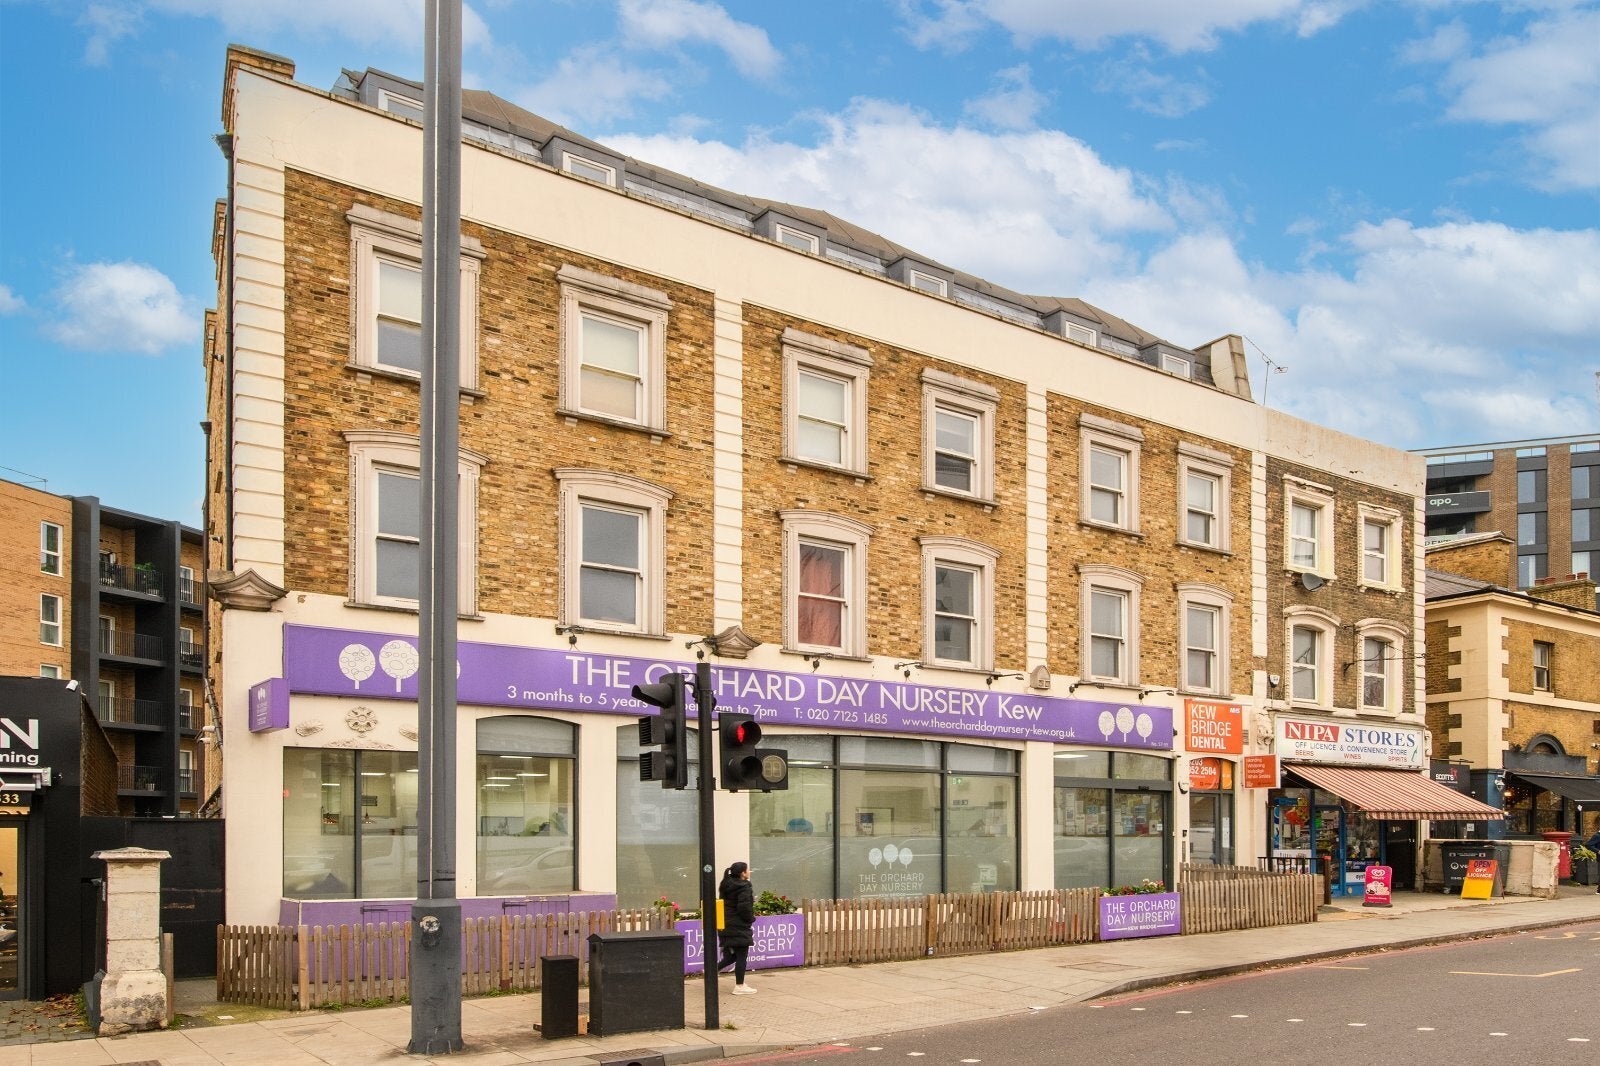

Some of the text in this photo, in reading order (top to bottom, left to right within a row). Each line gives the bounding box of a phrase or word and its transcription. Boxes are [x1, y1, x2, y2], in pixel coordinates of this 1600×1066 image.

[565, 655, 1043, 721] THE ORHARD DAY NURSERY Kew
[507, 686, 517, 698] 3
[523, 688, 574, 703] months
[580, 692, 593, 704] to
[597, 693, 607, 705] 5
[612, 696, 648, 710] years
[737, 703, 749, 714] to
[753, 704, 777, 720] 7pm
[793, 707, 803, 719] T:
[807, 708, 829, 720] 020
[833, 709, 858, 723] 7125
[863, 712, 888, 725] 1485
[1191, 704, 1217, 720] KEW
[901, 717, 1075, 740] www.theorcharddaynursery-kew.org.uk
[1191, 720, 1231, 737] BRIDGE
[1287, 722, 1415, 748] NIPA STORES
[1191, 735, 1227, 750] DENTAL
[1295, 741, 1307, 749] OFF
[1310, 742, 1336, 751] LICENCE
[1346, 745, 1387, 755] CONVENIENCE
[1390, 747, 1407, 756] STORE
[1343, 752, 1362, 760] WINES
[1387, 755, 1408, 763] SPIRITS
[1200, 766, 1217, 775] 2504
[1473, 860, 1492, 868] OPEN
[858, 872, 924, 883] THE ORCHARD
[859, 882, 924, 892] DAY NURSERY
[1106, 899, 1176, 914] THE ORCHARD
[1107, 911, 1175, 926] DAY NURSERY
[685, 923, 797, 943] TH HARD
[687, 937, 795, 958] DA RSERY
